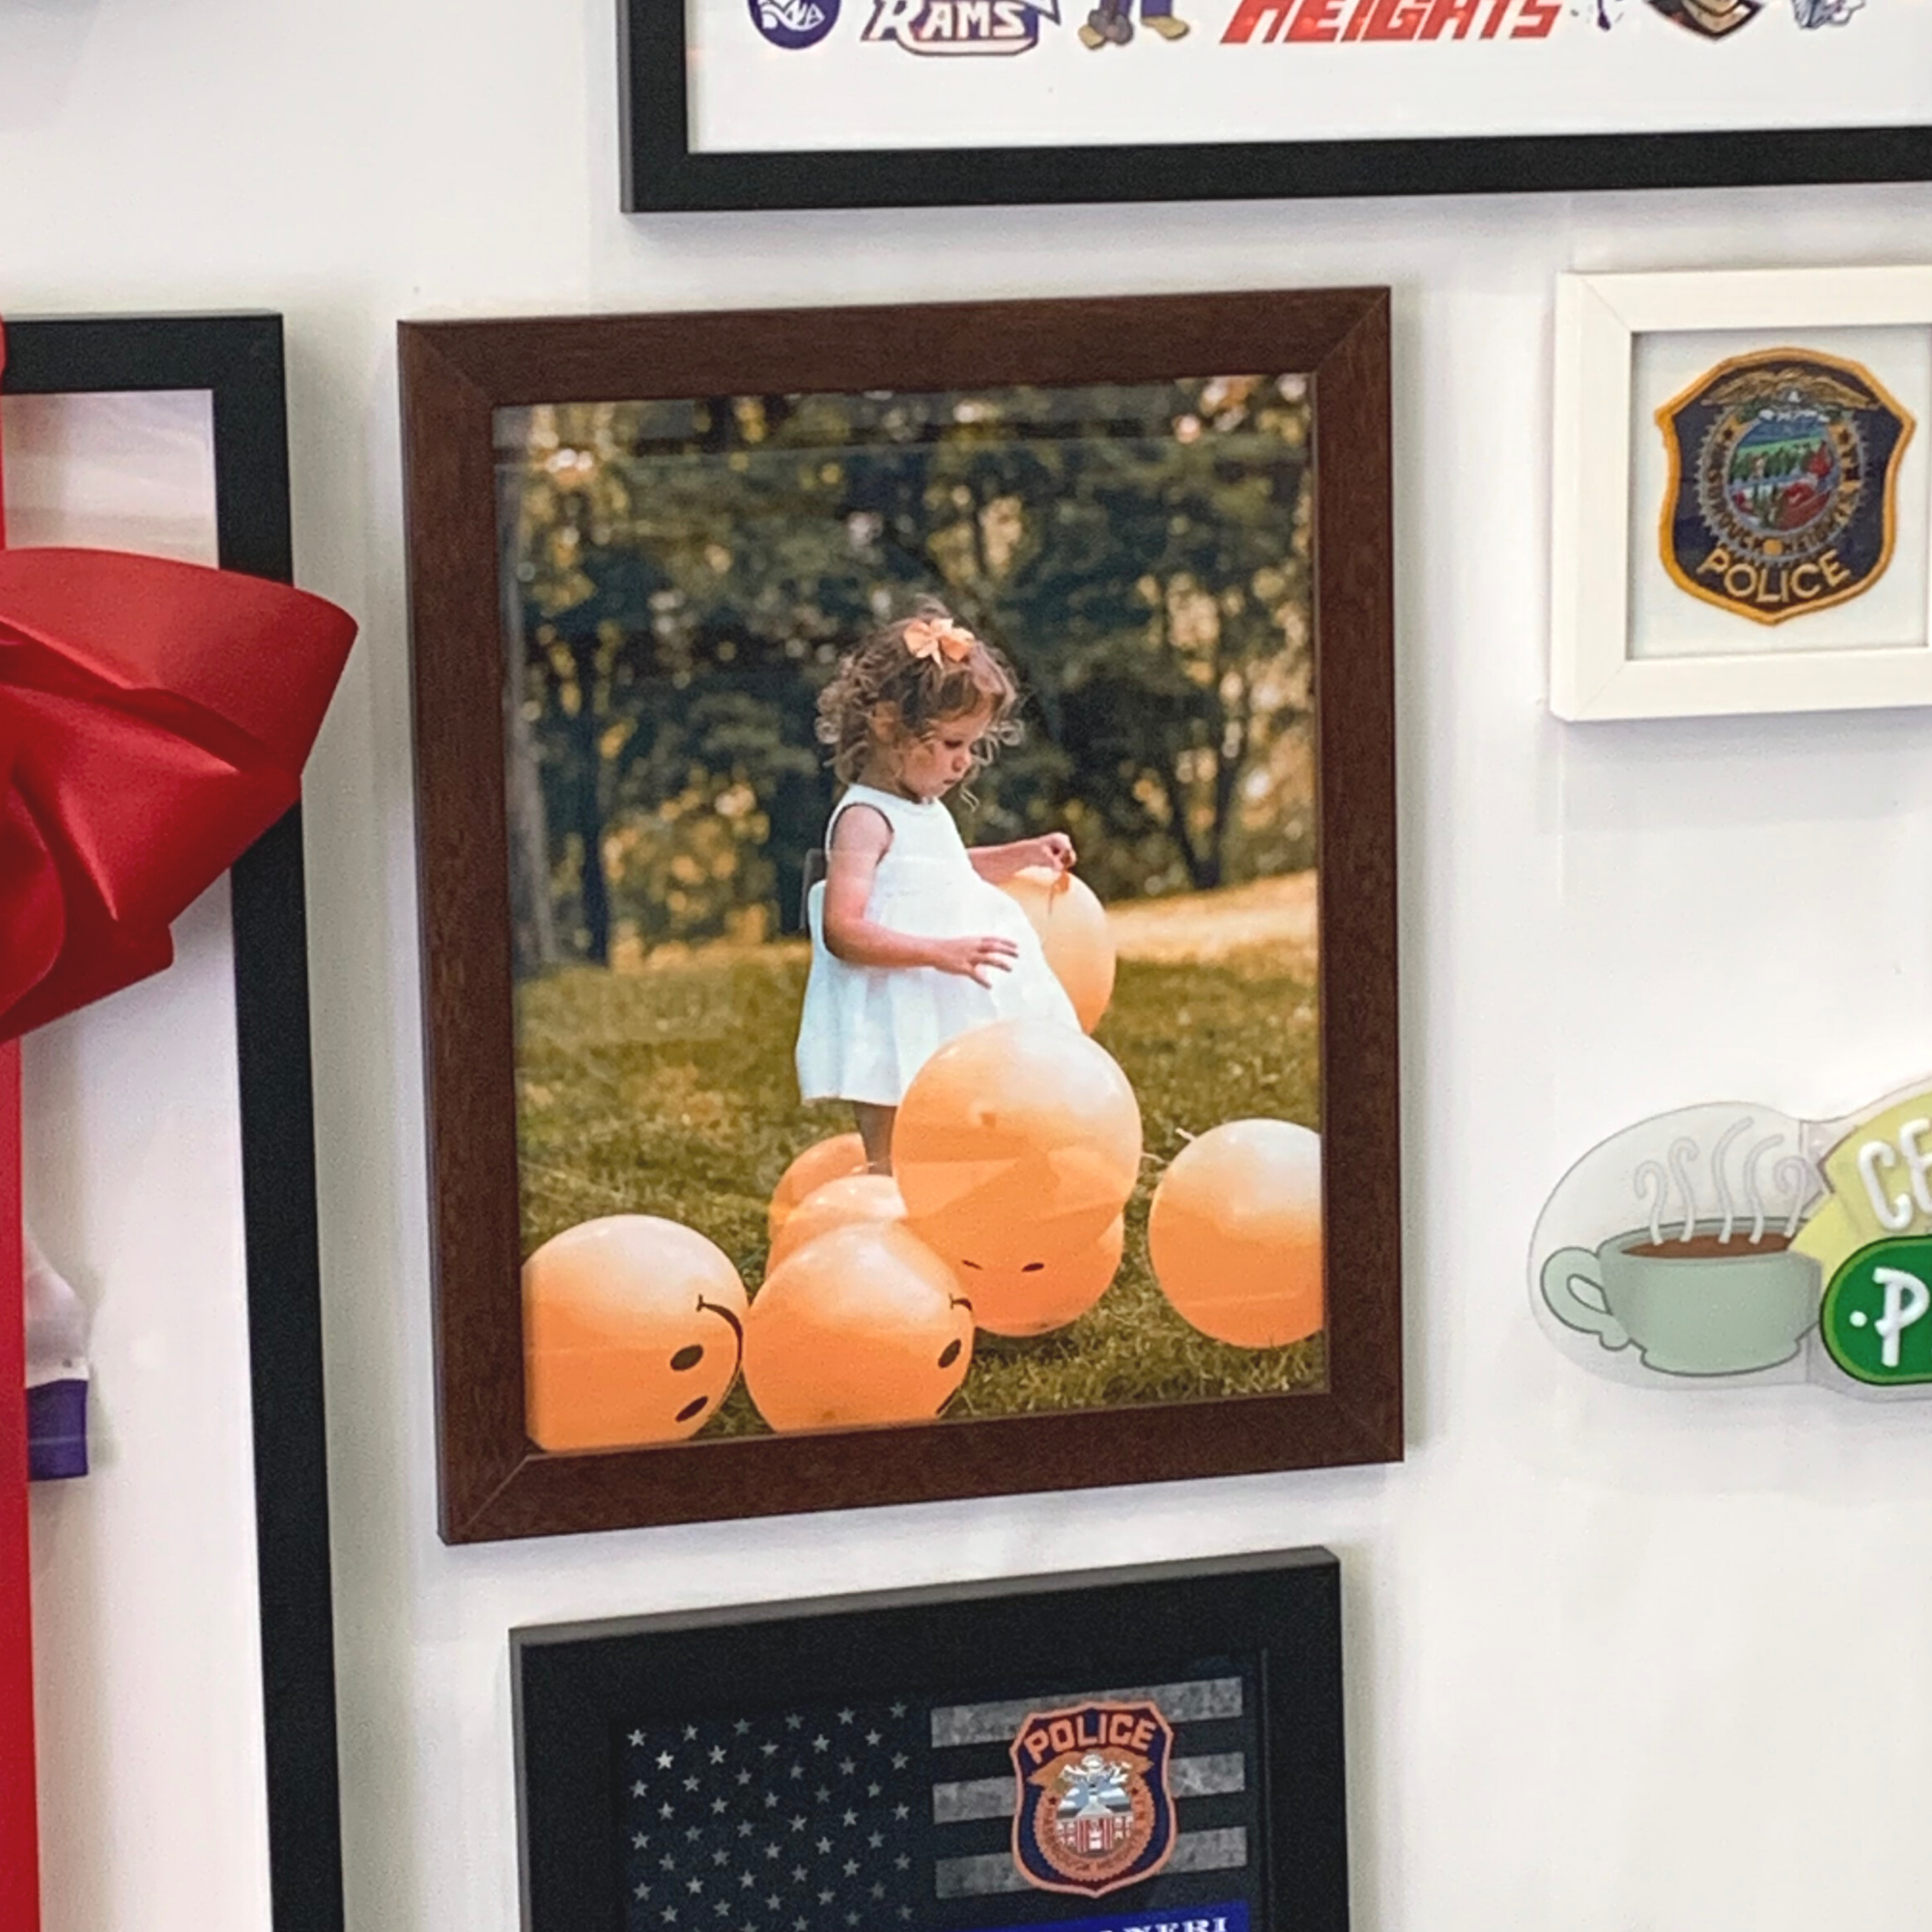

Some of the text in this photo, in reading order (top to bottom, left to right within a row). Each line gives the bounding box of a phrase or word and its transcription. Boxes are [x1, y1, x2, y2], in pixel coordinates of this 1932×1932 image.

[860, 0, 1032, 46] RAMS
[1696, 549, 1851, 603] POLICE
[1024, 1714, 1156, 1764] POLICE
